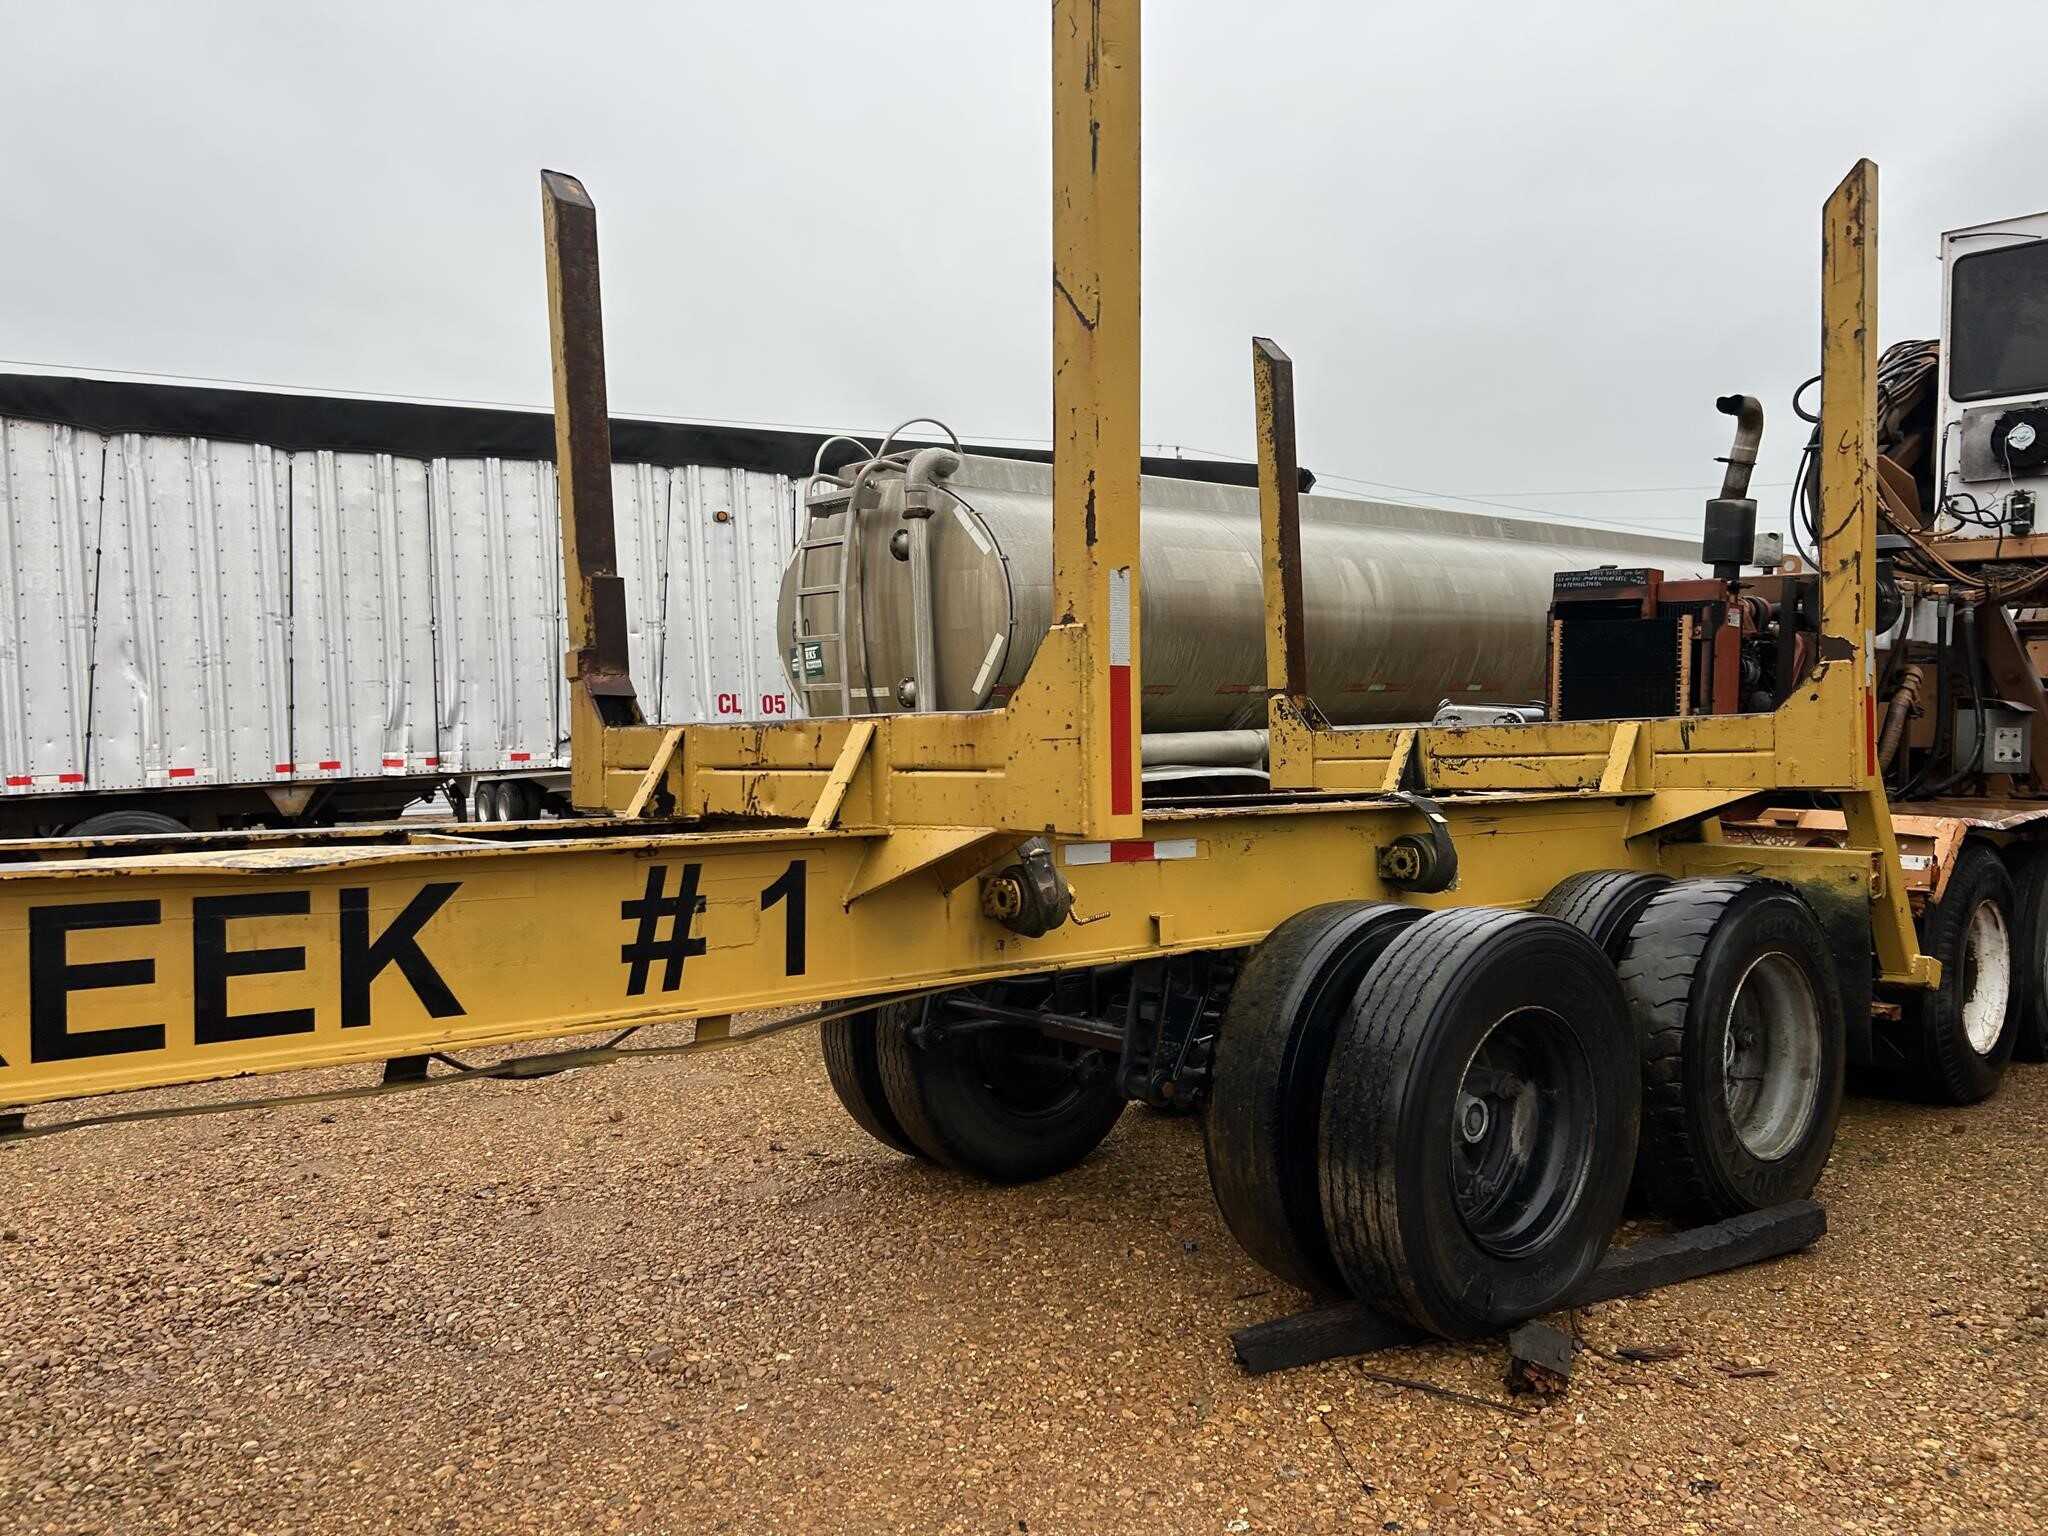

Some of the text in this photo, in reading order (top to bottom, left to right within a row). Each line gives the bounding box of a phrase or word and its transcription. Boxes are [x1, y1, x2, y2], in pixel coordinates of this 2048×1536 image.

[718, 693, 786, 714] CL 05
[0, 881, 467, 1067] EEK
